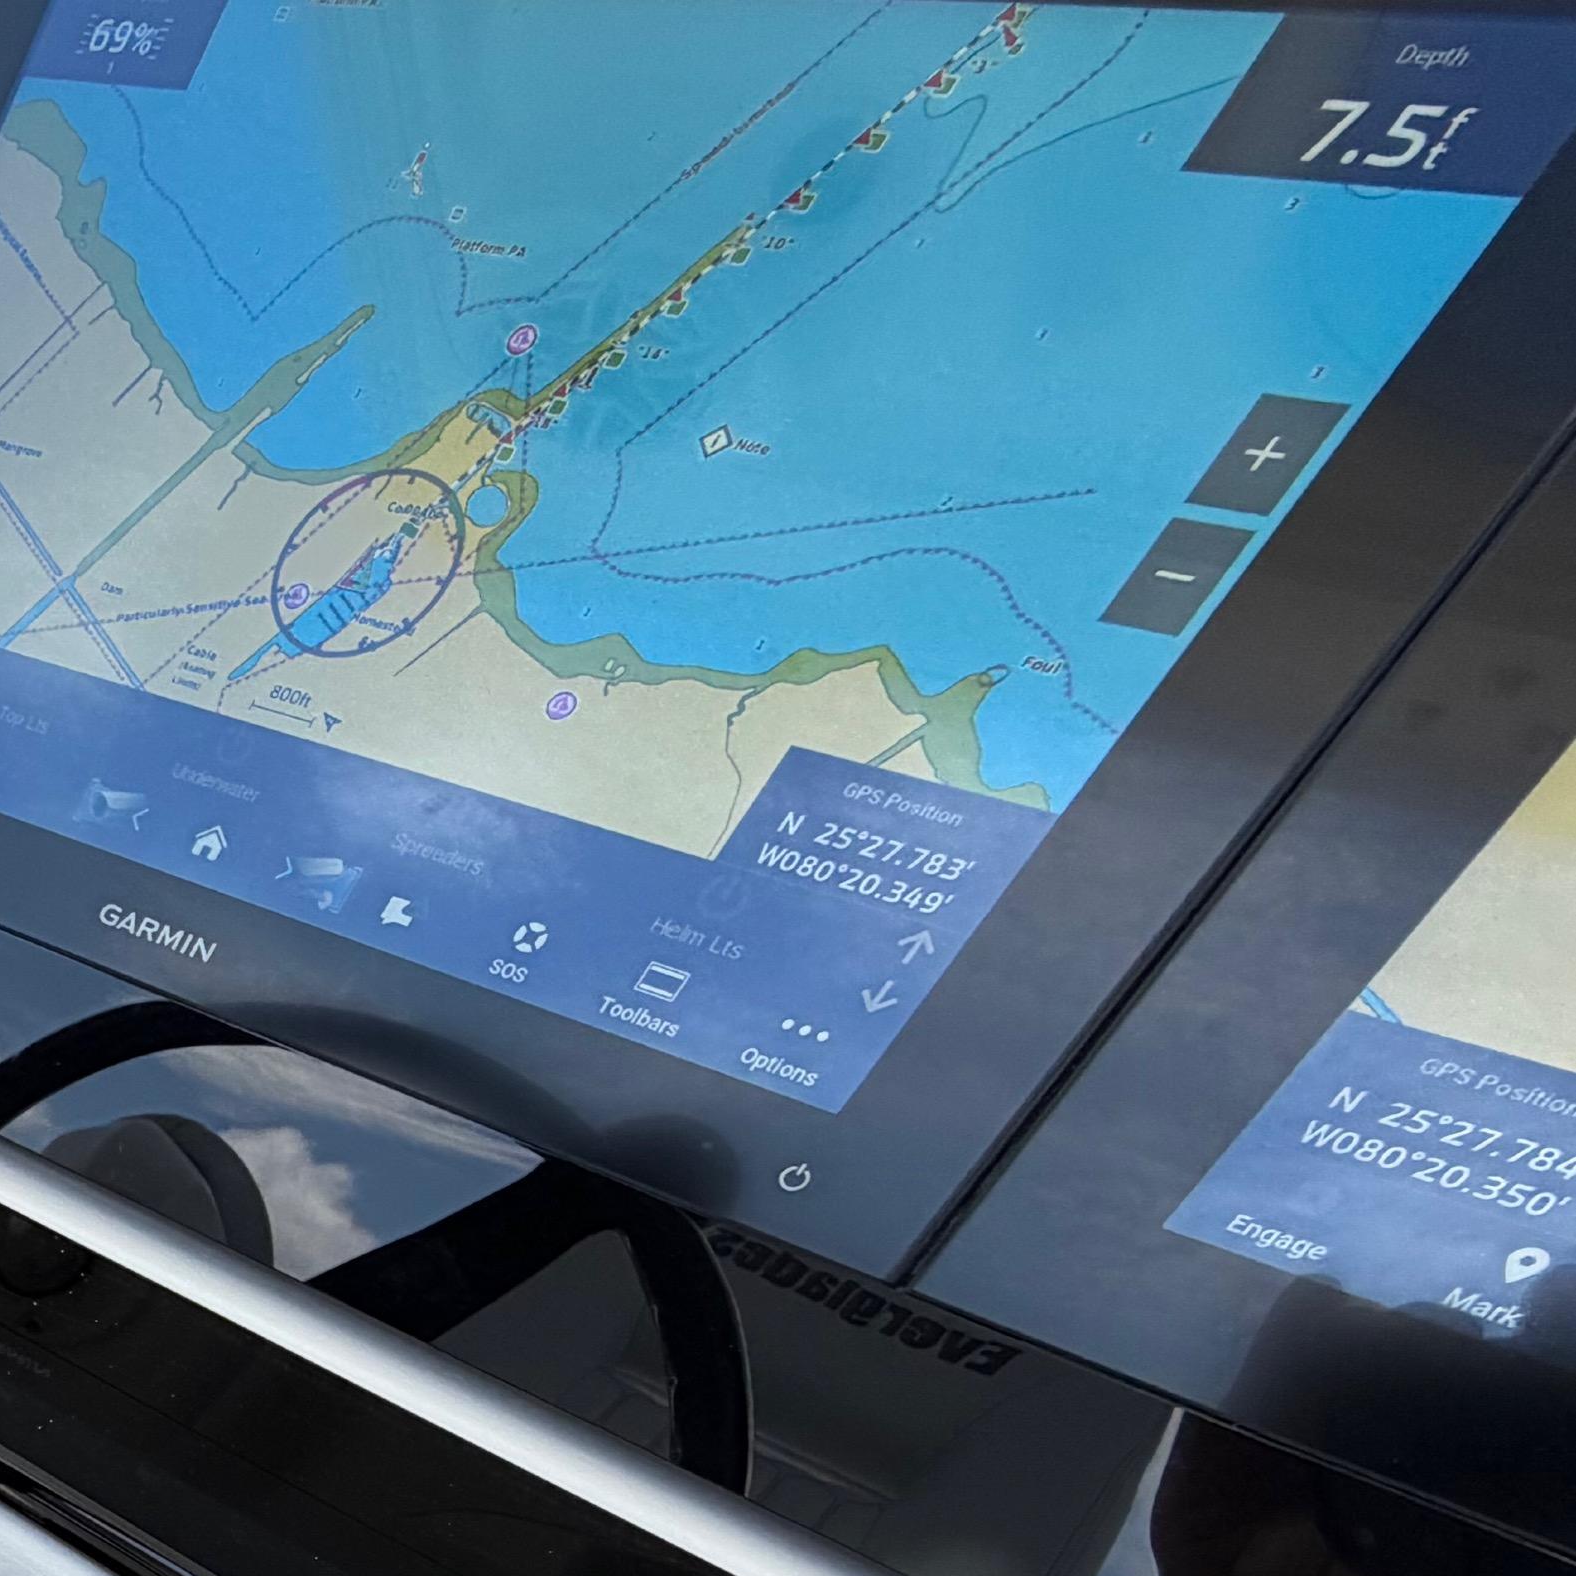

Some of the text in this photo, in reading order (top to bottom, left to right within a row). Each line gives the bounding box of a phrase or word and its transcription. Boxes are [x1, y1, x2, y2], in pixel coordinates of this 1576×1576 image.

[89, 18, 152, 56] 69%
[1395, 43, 1471, 71] Depth
[451, 237, 507, 255] Platform
[1021, 655, 1063, 676] Foul
[270, 685, 312, 709] 800ft
[172, 762, 260, 803] Underwater
[842, 779, 964, 827] GPS Position
[779, 810, 799, 835] N
[391, 832, 485, 877] Spreaders
[98, 903, 218, 963] GARMIN
[489, 958, 529, 984] SOS
[599, 997, 678, 1039] Toolbars
[739, 1045, 818, 1089] Options
[1419, 1058, 1478, 1085] GPS
[1328, 1085, 1367, 1114] N
[1226, 1213, 1328, 1262] Engage
[1442, 1286, 1526, 1329] Mark
